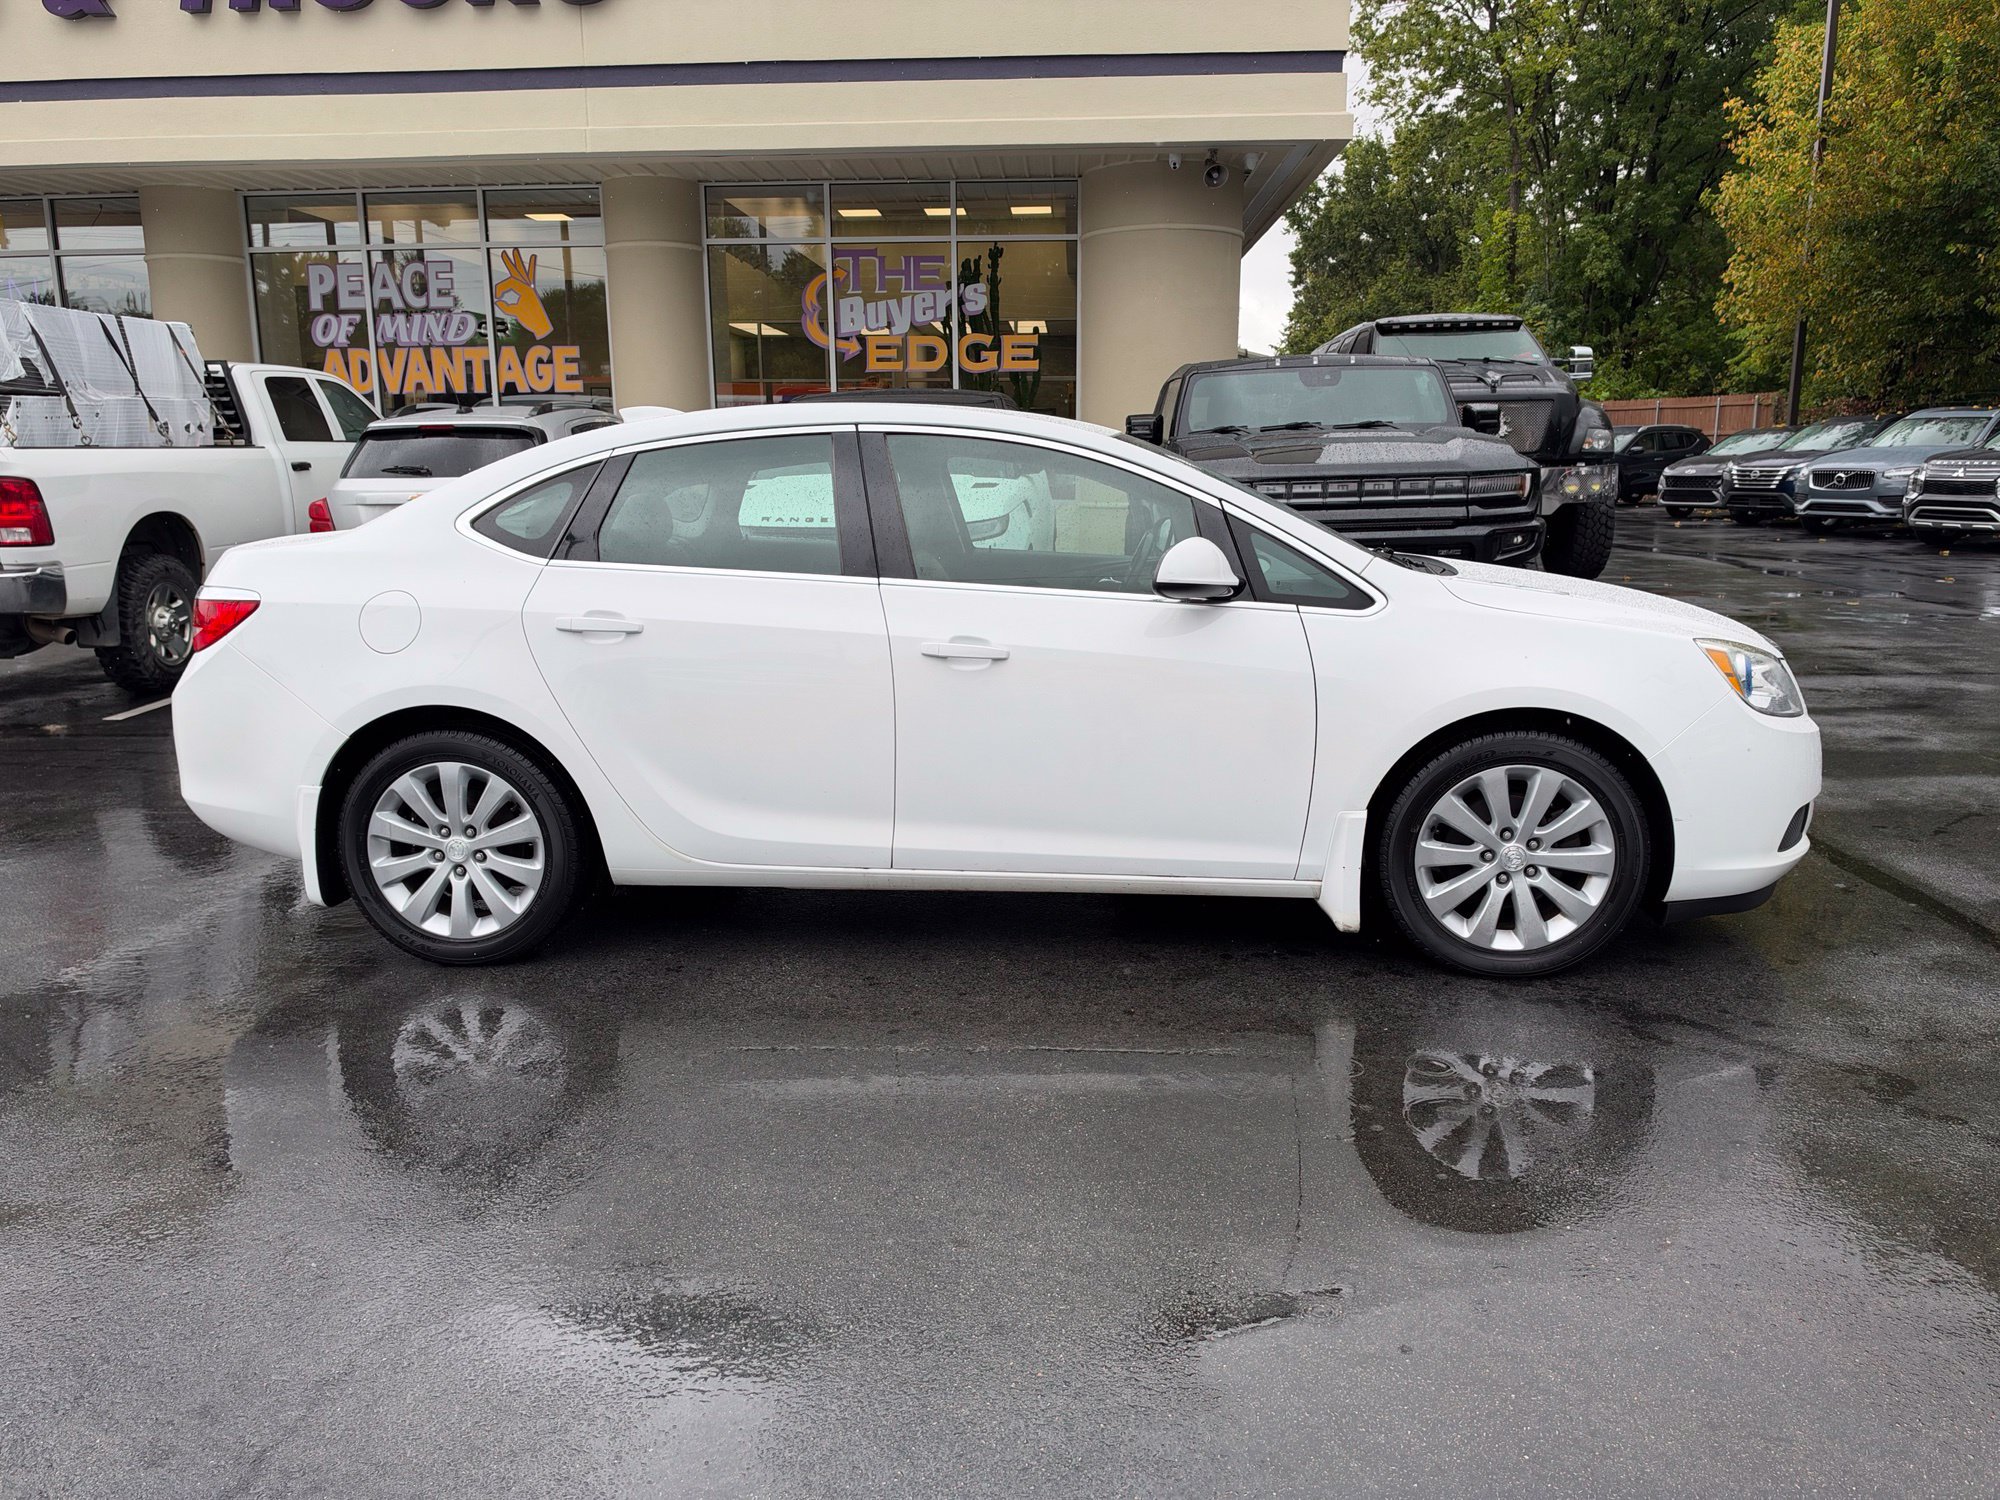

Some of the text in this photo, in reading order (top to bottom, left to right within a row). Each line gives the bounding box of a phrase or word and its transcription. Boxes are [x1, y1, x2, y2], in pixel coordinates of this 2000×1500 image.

[306, 260, 457, 311] PEACE
[833, 248, 946, 294] THE
[311, 313, 361, 347] OF
[375, 312, 478, 347] MIND
[322, 345, 584, 395] ADVANTAGE
[864, 333, 1040, 373] EDGE
[490, 754, 541, 800] YOKOHAMA
